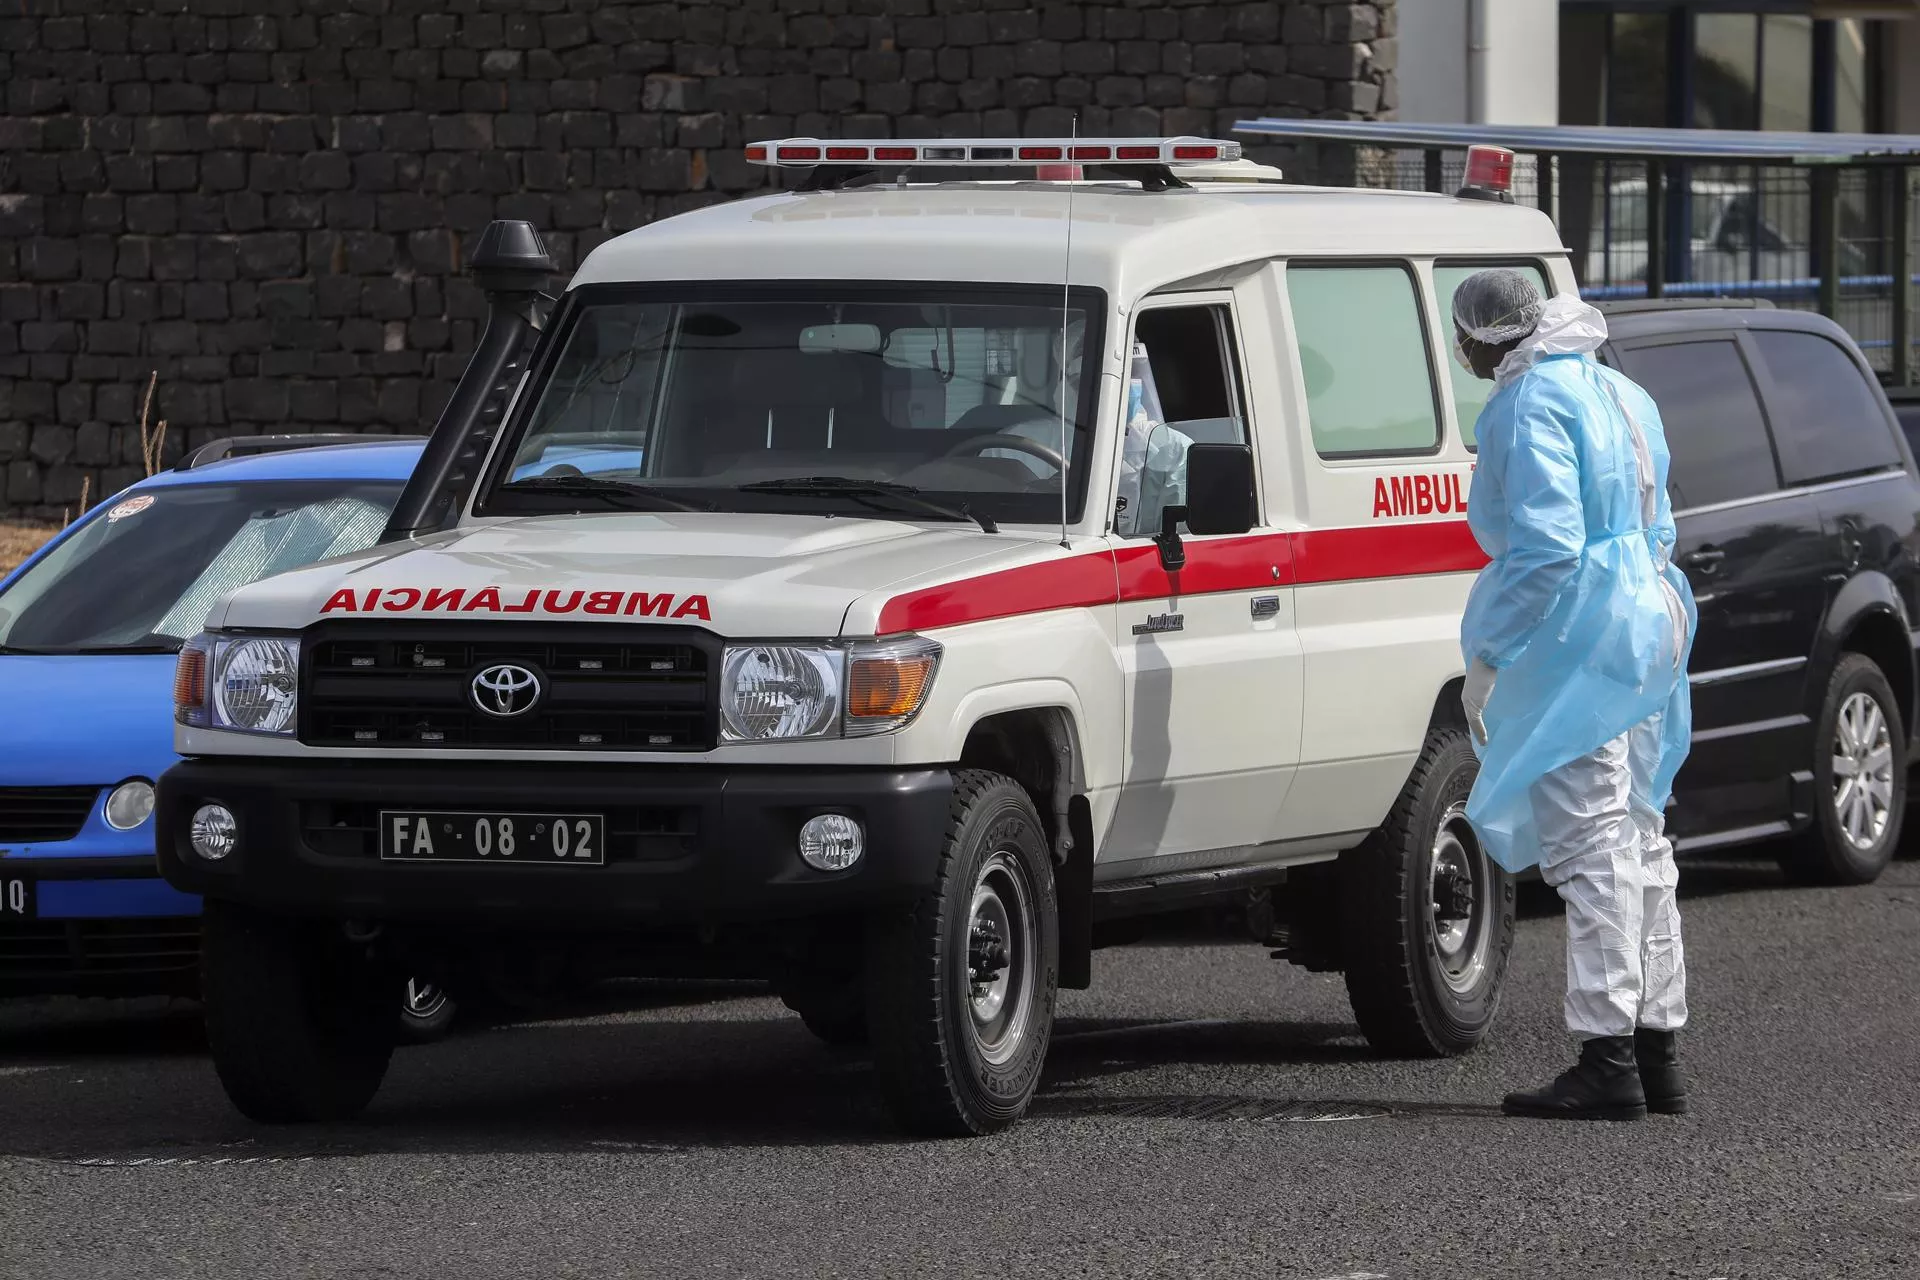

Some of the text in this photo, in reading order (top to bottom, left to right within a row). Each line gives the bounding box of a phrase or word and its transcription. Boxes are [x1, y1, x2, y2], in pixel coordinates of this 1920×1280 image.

[1373, 473, 1467, 517] AMBUL
[393, 817, 592, 858] FA 08 02
[0, 879, 24, 914] Q
